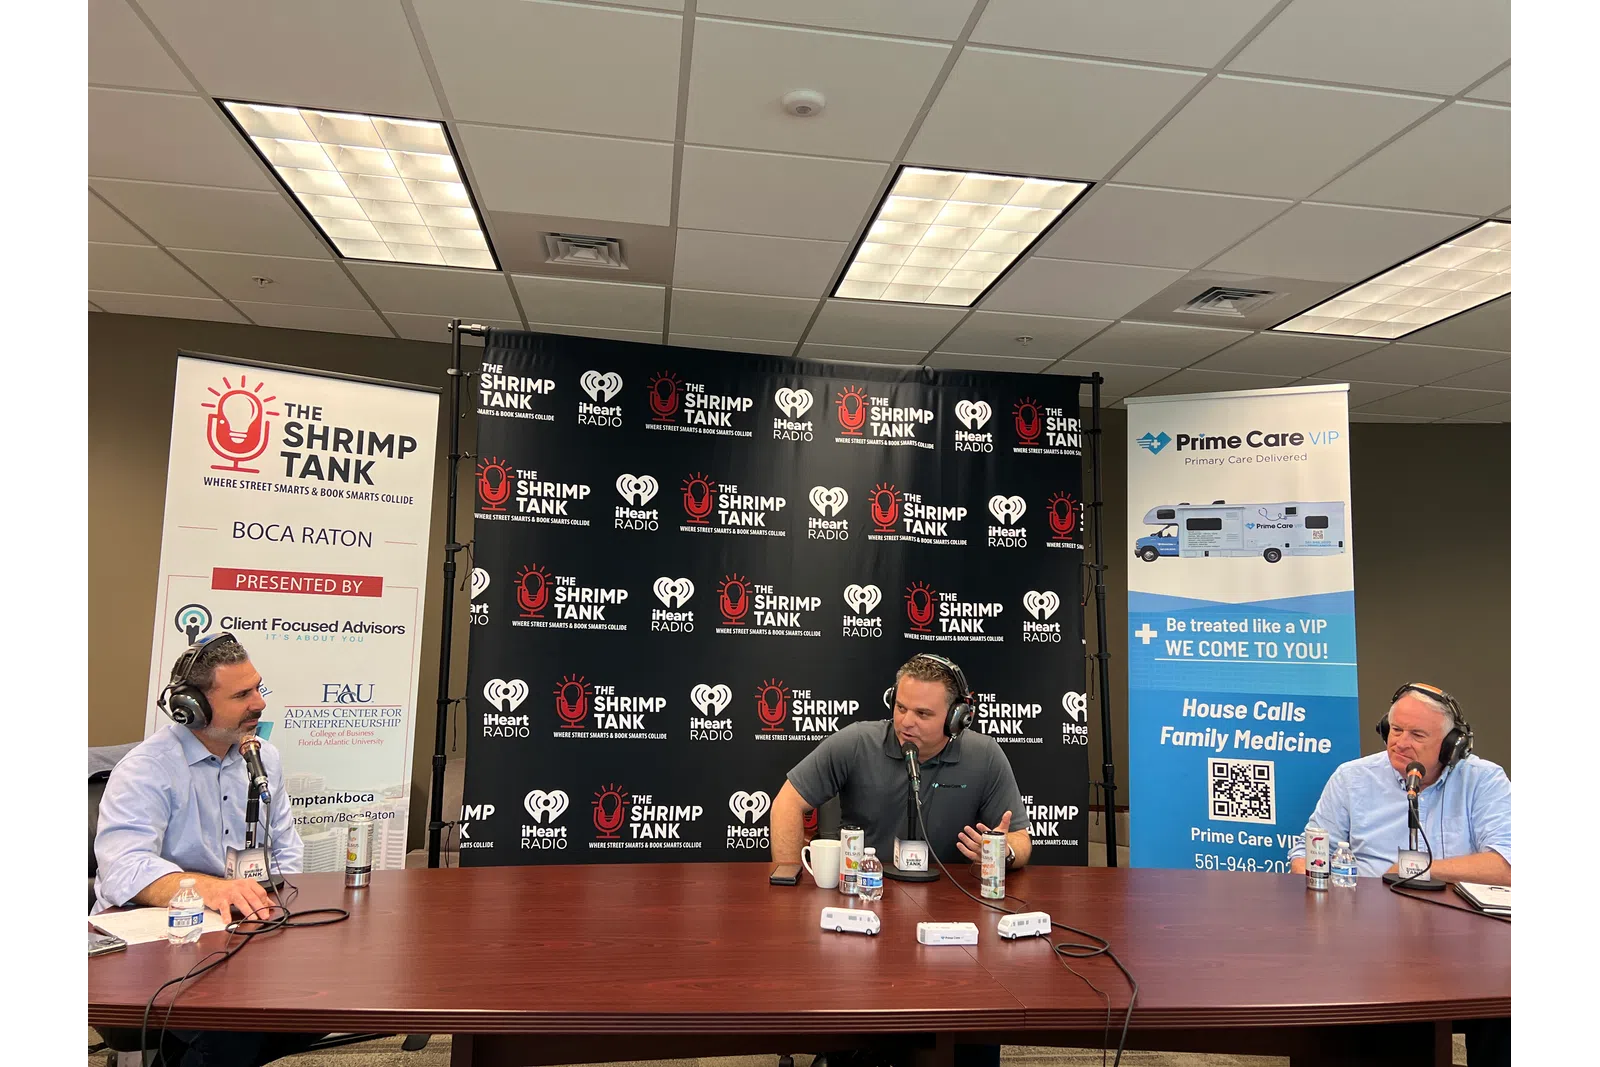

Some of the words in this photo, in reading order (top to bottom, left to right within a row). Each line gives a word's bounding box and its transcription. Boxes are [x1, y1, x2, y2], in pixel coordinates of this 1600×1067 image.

[482, 362, 503, 374] THE
[480, 373, 555, 394] SHRIMP
[685, 383, 704, 393] THE
[480, 389, 532, 410] TANK
[685, 393, 753, 412] SHRIMP
[870, 396, 889, 407] THE
[284, 403, 322, 421] THE
[579, 402, 622, 416] iHeart
[870, 406, 934, 424] SHRIMP
[1045, 408, 1062, 416] THE
[578, 414, 622, 427] RADIO
[684, 409, 732, 427] TANK
[774, 418, 813, 432] iHeart
[1046, 417, 1081, 432] SHR
[773, 429, 814, 442] RADIO
[870, 422, 915, 438] TANK
[955, 430, 993, 443] iHeart
[282, 421, 417, 459] SHRIMP
[1176, 434, 1242, 451] Prime
[1246, 431, 1304, 448] Care
[1308, 431, 1339, 445] VIP
[955, 442, 993, 453] RADIO
[1184, 456, 1225, 466] Primary
[1228, 456, 1252, 464] Care
[1256, 453, 1307, 463] Delivered
[280, 451, 375, 485] TANK
[516, 469, 537, 480] THE
[204, 477, 237, 488] WHERE
[239, 480, 272, 491] STREET
[274, 484, 309, 495] SMARTS
[311, 487, 318, 496] &
[320, 488, 344, 498] BOOK
[346, 490, 379, 501] SMARTS
[381, 494, 413, 505] COLLIDE
[516, 480, 591, 500] SHRIMP
[718, 484, 738, 494] THE
[719, 494, 786, 512] SHRIMP
[903, 493, 921, 503] THE
[516, 497, 568, 516] TANK
[615, 506, 658, 520] iHeart
[903, 502, 967, 521] SHRIMP
[615, 518, 659, 531] RADIO
[718, 510, 765, 527] TANK
[808, 517, 848, 530] iHeart
[903, 518, 948, 536] TANK
[988, 525, 1027, 538] iHeart
[233, 521, 295, 543] BOCA
[302, 527, 372, 548] RATON
[808, 529, 849, 541] RADIO
[988, 537, 1027, 548] RADIO
[236, 574, 336, 592] PRESENTED
[342, 580, 363, 593] BY
[555, 576, 576, 586] THE
[555, 586, 628, 604] SHRIMP
[754, 585, 773, 594] THE
[754, 594, 821, 611] SHRIMP
[939, 593, 957, 601] THE
[470, 603, 489, 614] art
[554, 603, 605, 621] TANK
[652, 609, 694, 622] iHeart
[939, 602, 1003, 617] SHRIMP
[220, 616, 268, 630] Client
[272, 618, 339, 633] Focused
[342, 621, 405, 635] Advisors
[753, 611, 801, 627] TANK
[843, 615, 882, 627] iHeart
[939, 618, 984, 633] TANK
[1167, 617, 1186, 632] Be
[1190, 619, 1248, 633] treated
[1253, 618, 1281, 633] like
[1285, 622, 1295, 633] a
[1299, 619, 1327, 634] VIP
[651, 621, 694, 633] RADIO
[843, 627, 882, 638] RADIO
[1023, 621, 1060, 632] iHeart
[1023, 632, 1061, 643] RADIO
[1165, 640, 1194, 656] WE
[1199, 640, 1249, 657] COME
[1254, 642, 1278, 658] TO
[1283, 642, 1328, 659] YOU!
[321, 684, 375, 704] FAU
[594, 685, 615, 695] THE
[792, 690, 811, 699] THE
[594, 696, 666, 712] SHRIMP
[977, 693, 996, 702] THE
[285, 709, 330, 718] ADAMS
[332, 709, 378, 718] CENTER
[381, 709, 401, 717] FOR
[792, 699, 859, 715] SHRIMP
[978, 703, 1042, 718] SHRIMP
[1183, 698, 1247, 719] House
[1253, 701, 1306, 722] Calls
[284, 719, 401, 728] ENTREPRENEURSHIP
[483, 713, 529, 726] iHeart
[594, 713, 645, 730] TANK
[690, 717, 732, 729] iHeart
[792, 716, 840, 732] TANK
[978, 719, 1023, 734] TANK
[310, 730, 336, 738] College
[483, 726, 530, 738] RADIO
[690, 730, 733, 741] RADIO
[1062, 722, 1088, 735] iHea
[351, 738, 384, 746] University
[1063, 734, 1088, 745] RAD
[1161, 726, 1229, 752] Family
[1234, 730, 1331, 753] Medicine
[289, 792, 374, 808] imptankboca
[632, 795, 652, 804] THE
[1021, 796, 1033, 804] HE
[630, 805, 703, 821] SHRIMP
[1026, 805, 1079, 821] HRIMP
[522, 824, 567, 838] iHeart
[629, 823, 680, 839] TANK
[727, 825, 769, 837] iHeart
[1025, 821, 1059, 836] ANK
[521, 838, 567, 849] RADIO
[727, 838, 769, 849] RADIO
[1191, 827, 1234, 844] Prime
[1238, 831, 1272, 847] Care
